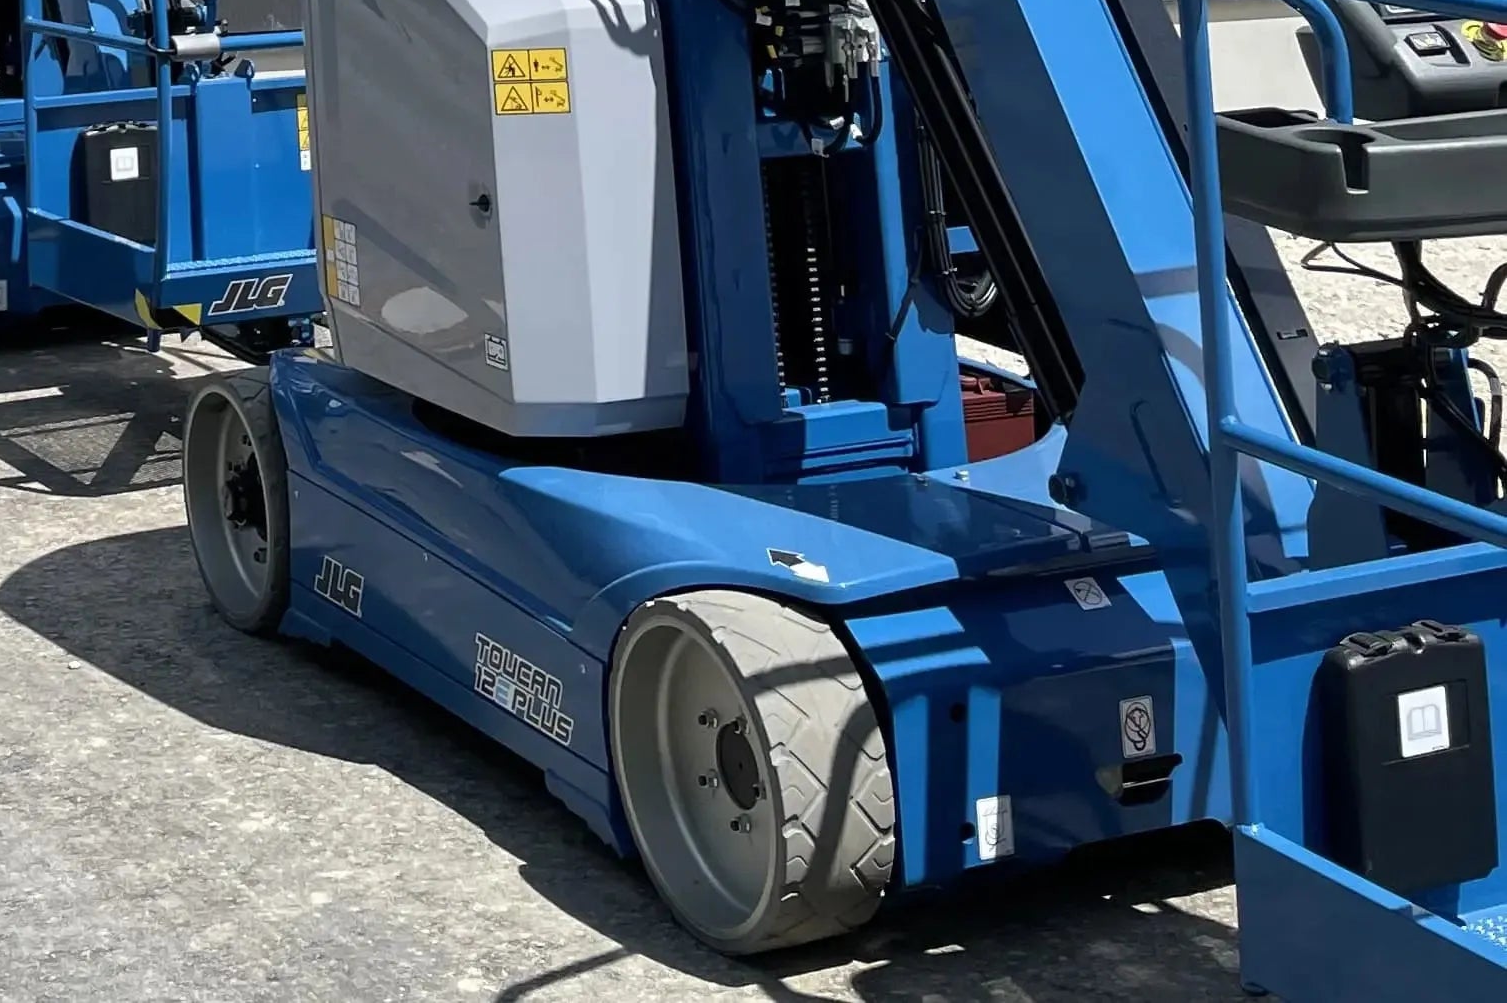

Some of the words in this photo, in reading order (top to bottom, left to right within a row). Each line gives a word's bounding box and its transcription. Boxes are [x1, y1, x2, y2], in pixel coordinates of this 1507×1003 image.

[208, 273, 293, 315] JLG
[314, 554, 364, 618] JLG
[475, 632, 563, 709] TOUCAN
